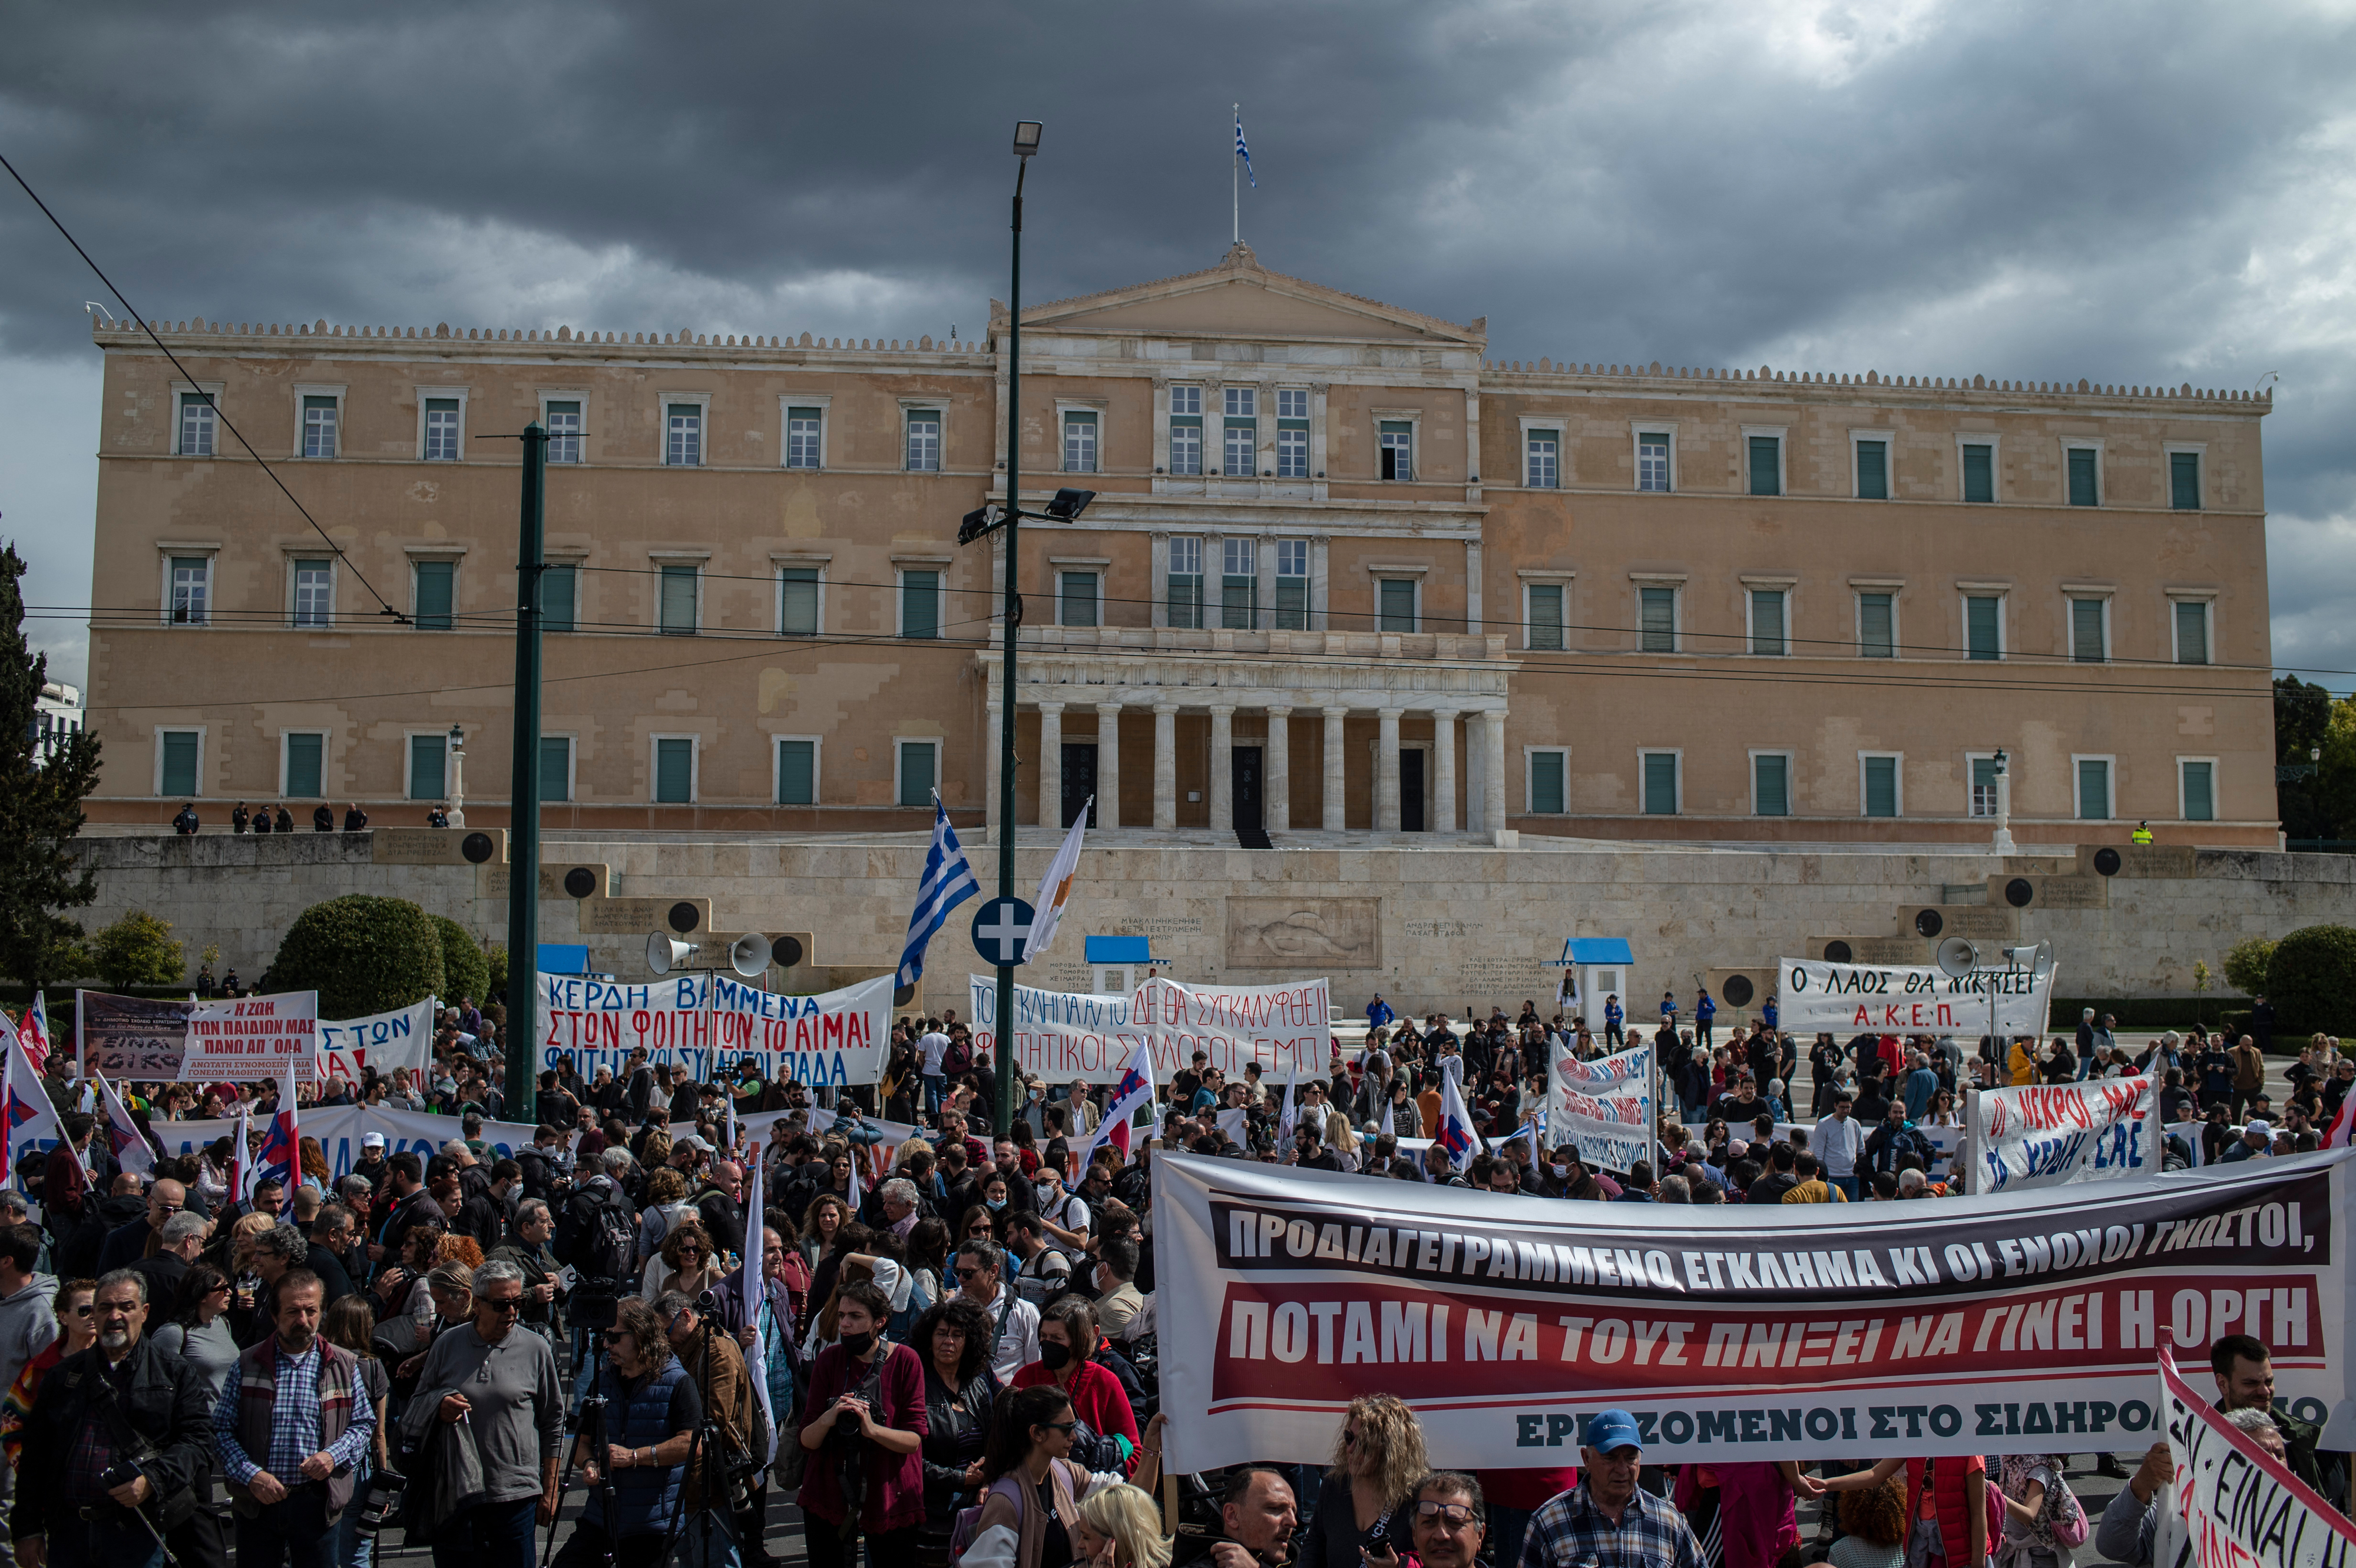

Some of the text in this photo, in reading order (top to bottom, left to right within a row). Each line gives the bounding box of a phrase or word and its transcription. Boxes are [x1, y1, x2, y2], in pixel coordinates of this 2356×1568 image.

[548, 976, 820, 1020] ΚΕΡΔΗ ΒΑΜΜΕΝΑ
[1791, 967, 1807, 993] Ο
[1825, 969, 1892, 994] ΛΑΟΣ
[1904, 972, 1935, 994] ΘΑ
[234, 1001, 275, 1016] Η ΖΩΗ
[971, 985, 994, 1024] ΤΟ
[1133, 985, 1157, 1025] ΔΕ
[1164, 987, 1189, 1026] ΘΑ
[191, 1019, 315, 1035] ΤΩΝ ΠΑΙΔΙΩΝ ΜΑΣ
[204, 1039, 243, 1054] ΠΑΝΩ
[547, 1010, 871, 1052] ΣΤΩΝ ΦΟΙΤΗΤΩΝ ΤΟ ΑΙΜΑ!
[975, 1032, 1107, 1072] ΦΤΗΤΙΚΟΙ
[1255, 1037, 1318, 1073] ΕΜΠ
[2018, 1086, 2093, 1131] ΝΕΚΡΟΙ
[2017, 1131, 2087, 1182] ΚΕΡΔΗ
[1229, 1201, 2315, 1289] ΠΡΟΔΙΑΓΕΓΡΑΜΜΕΝΟ ΕΓΚΛΗΜΑ ΚΙ ΟΙ ΕΝΟΧΟΙ ΓΝΩΣΤΟΙ,
[1229, 1288, 2308, 1368] ΠΟΤΑΜΙ ΝΑ ΤΟΥΣ ΠΝΙΞΕΙ ΝΑ ΓΙΝΕΙ Η ΟΡΓΗ
[1868, 1404, 1962, 1438] ΣΤΟ
